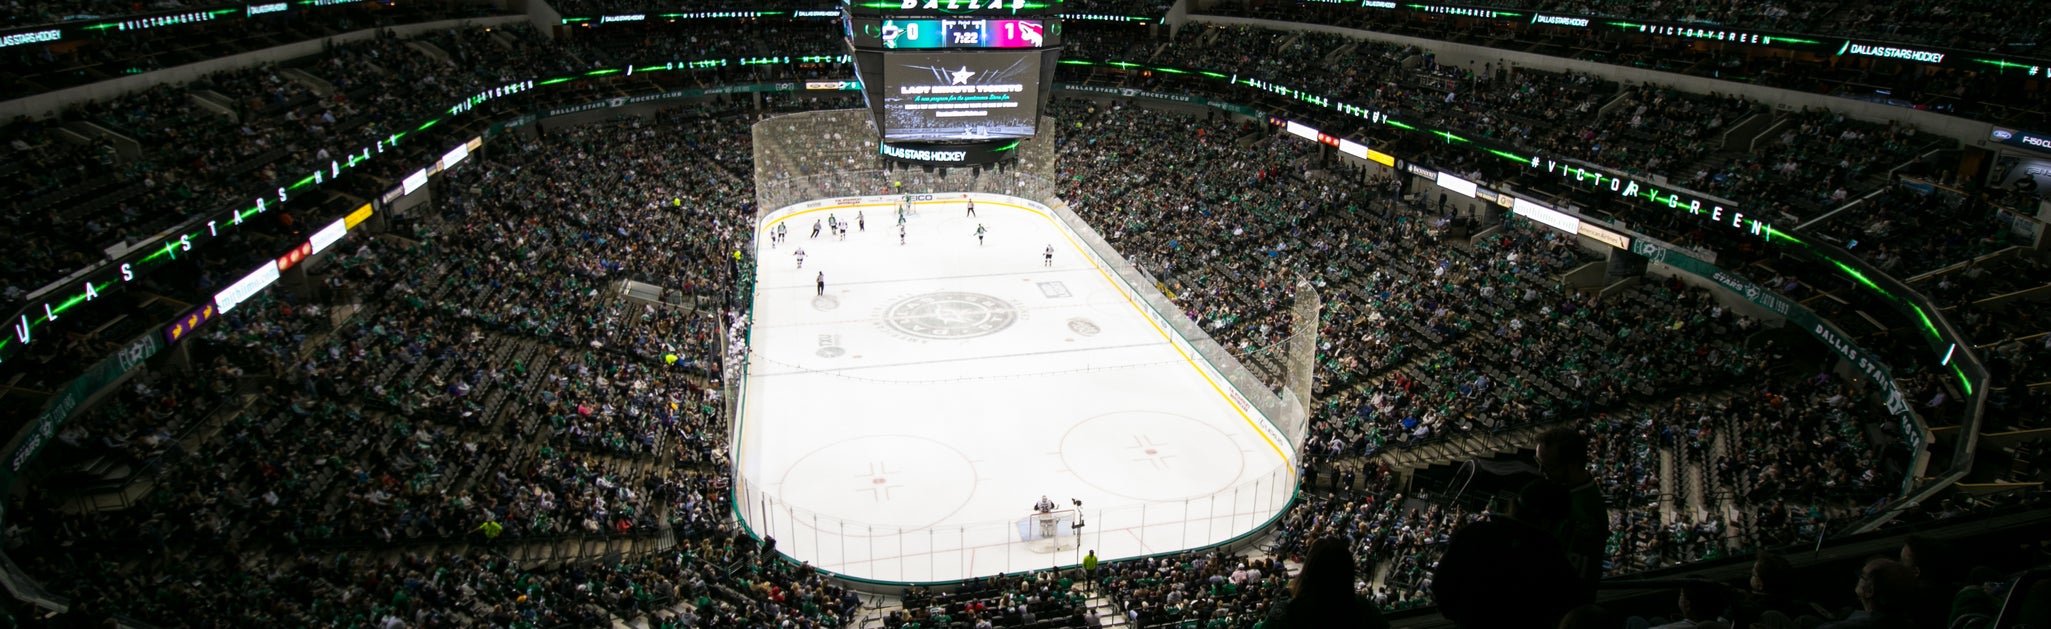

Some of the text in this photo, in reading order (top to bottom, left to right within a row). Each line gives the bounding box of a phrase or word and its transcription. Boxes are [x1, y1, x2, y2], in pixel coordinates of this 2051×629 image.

[118, 12, 215, 31] #VICTORYGREEN
[906, 22, 919, 40] 0
[1004, 22, 1015, 40] 1
[953, 32, 978, 44] 7:22
[1640, 24, 1771, 45] #VICTORYGREEN
[740, 55, 790, 66] STARS
[1850, 44, 1945, 64] DALLAS STARS HOCKEY
[1065, 84, 1094, 93] DALLAS
[1140, 91, 1169, 100] HOCKEY
[1250, 78, 1286, 96] DALLAS
[1294, 90, 1328, 108] STARS
[550, 91, 682, 116] DALLAS STARS HOCKEY CLUB
[2022, 136, 2042, 146] F-150
[884, 144, 966, 161] DALLAS STARS HOCKEY
[1530, 156, 1762, 236] #VICTORYGREEN
[180, 187, 288, 252] STARS
[1712, 272, 1744, 292] STARS
[1815, 324, 1858, 360] DALLAS
